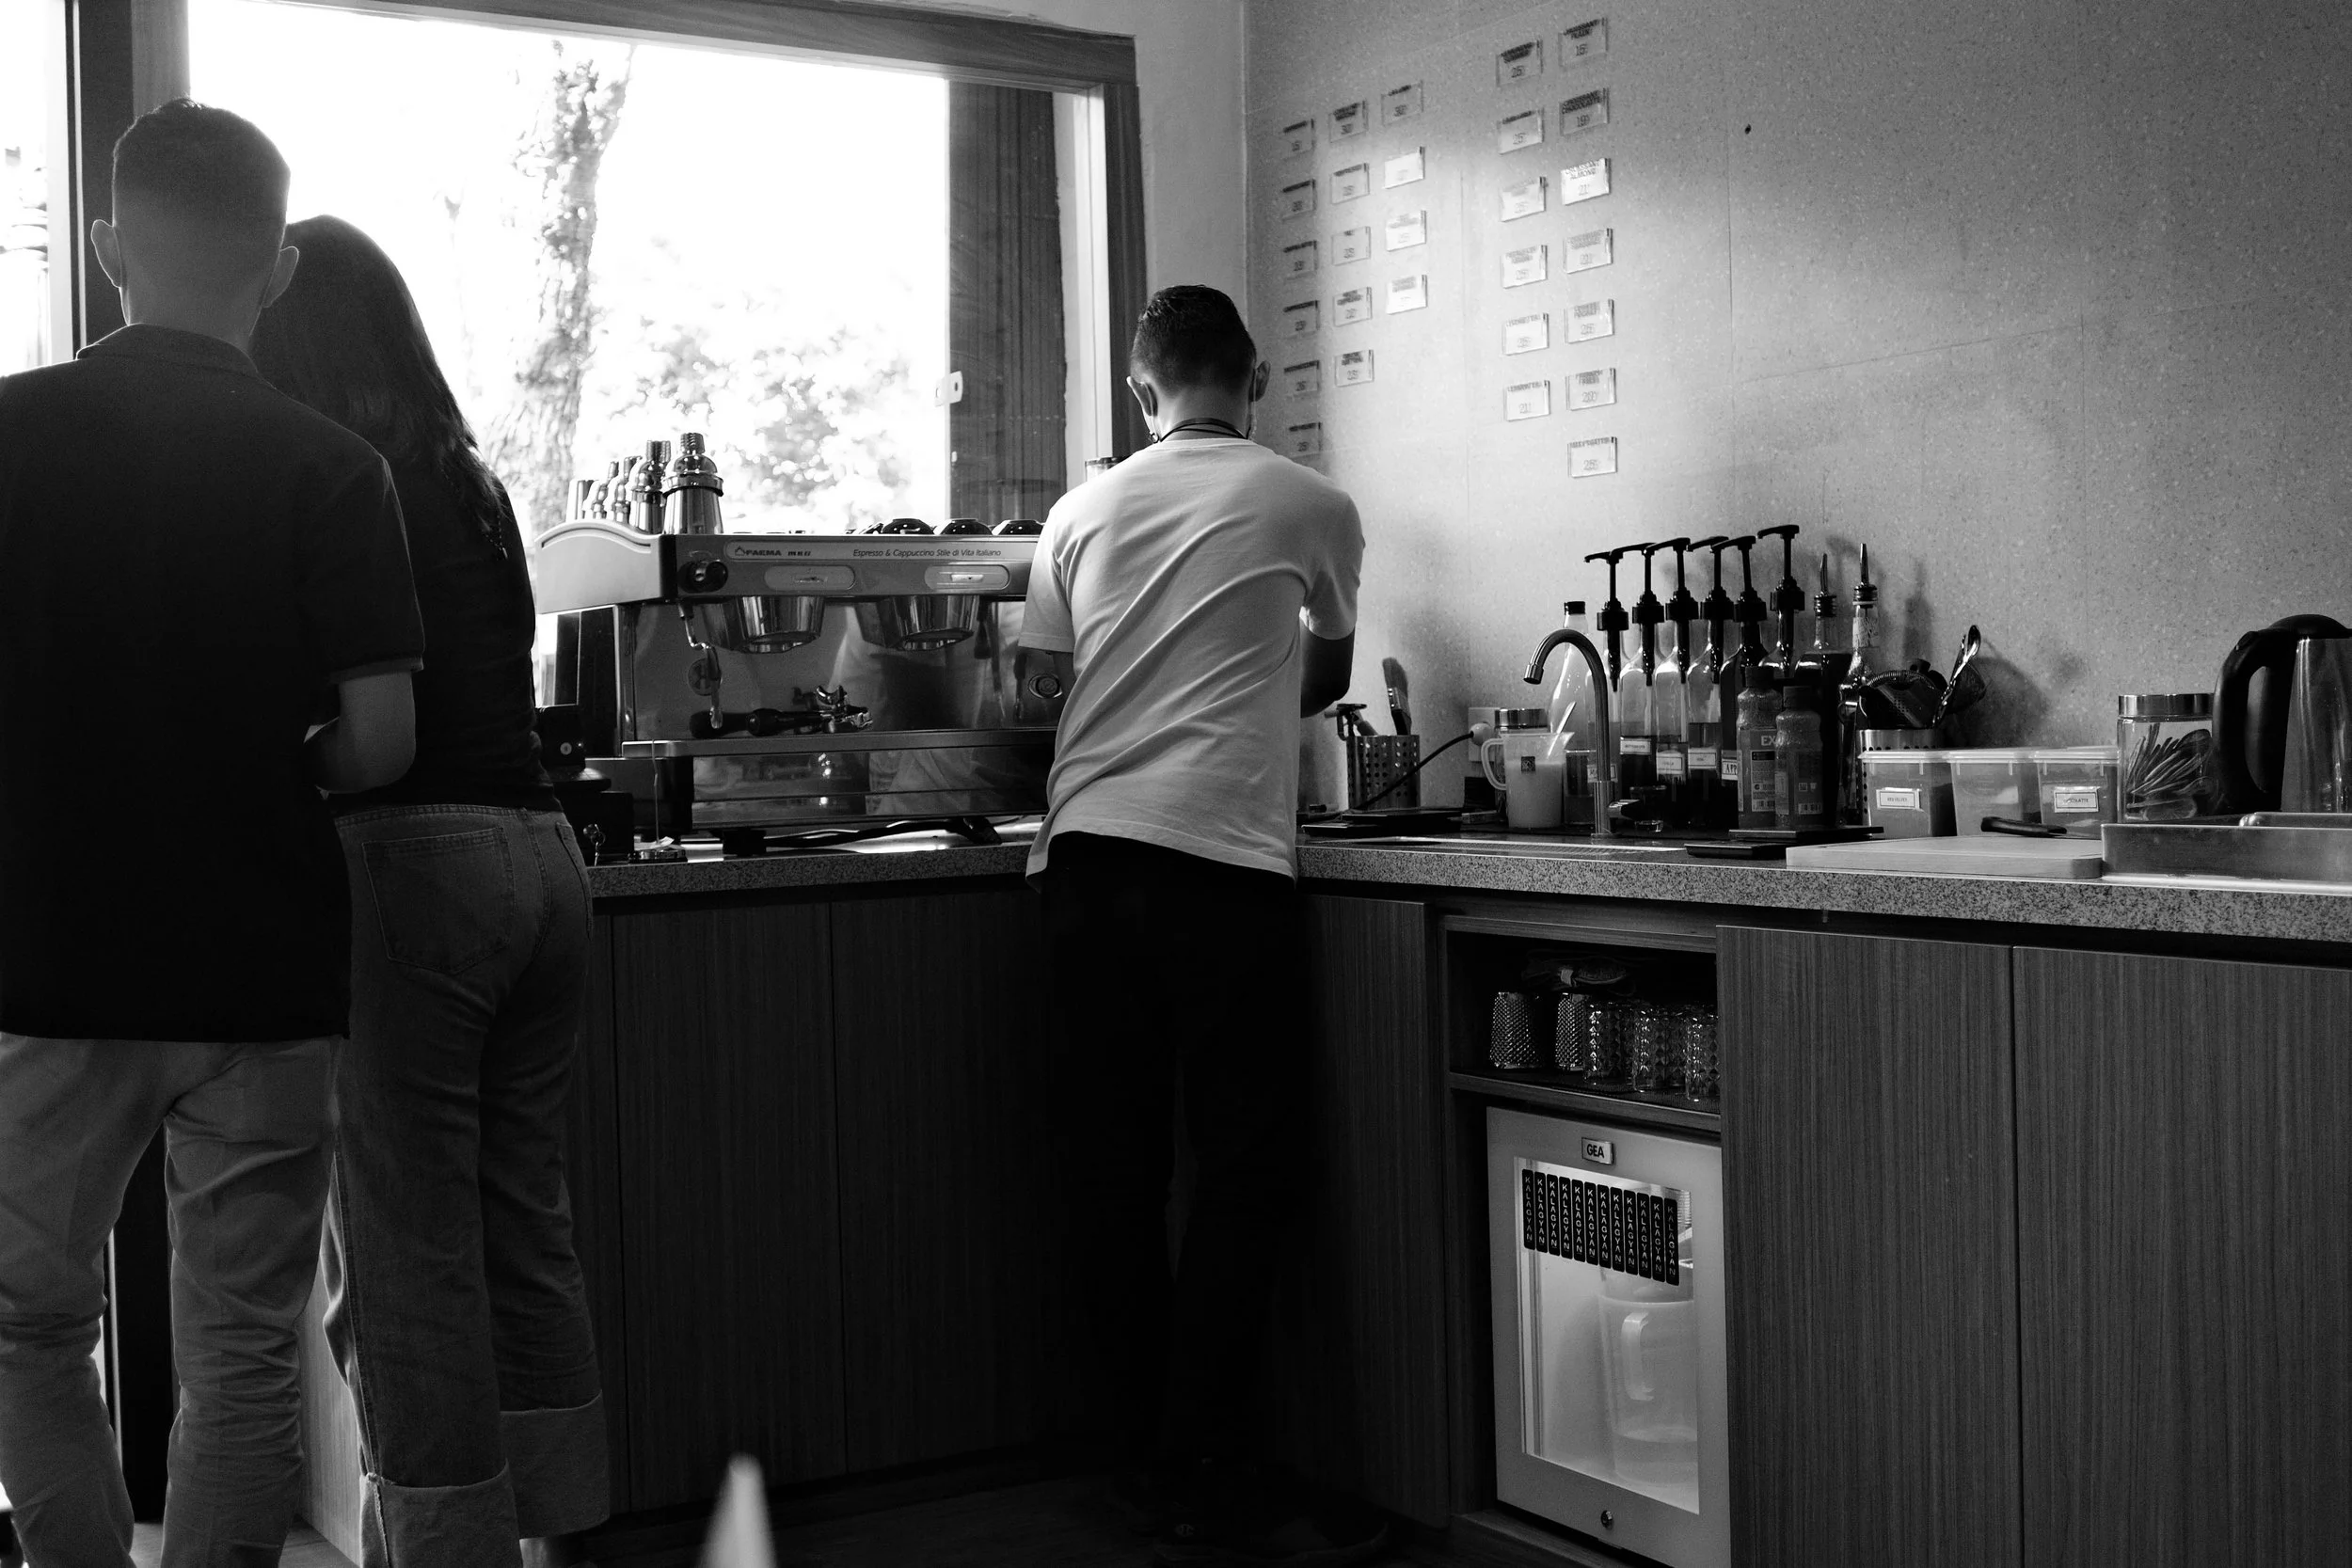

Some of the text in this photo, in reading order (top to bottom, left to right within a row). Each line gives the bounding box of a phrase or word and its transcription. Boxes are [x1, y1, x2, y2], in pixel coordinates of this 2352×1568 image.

[852, 549, 883, 558] Espresso
[893, 548, 935, 558] Cappuccino
[1586, 1143, 1605, 1159] GEA
[1574, 1187, 1582, 1254] KALAGYAN
[1587, 1189, 1596, 1257] KALAGYAN
[1600, 1192, 1609, 1259] KALAGYAN
[1613, 1195, 1622, 1262] KALAGYAN
[1627, 1197, 1635, 1266] KALAGYAN
[1640, 1200, 1648, 1269] KALAGYAN
[1654, 1203, 1662, 1273] KALAGYAN
[1667, 1206, 1676, 1275] KALAGYAN
